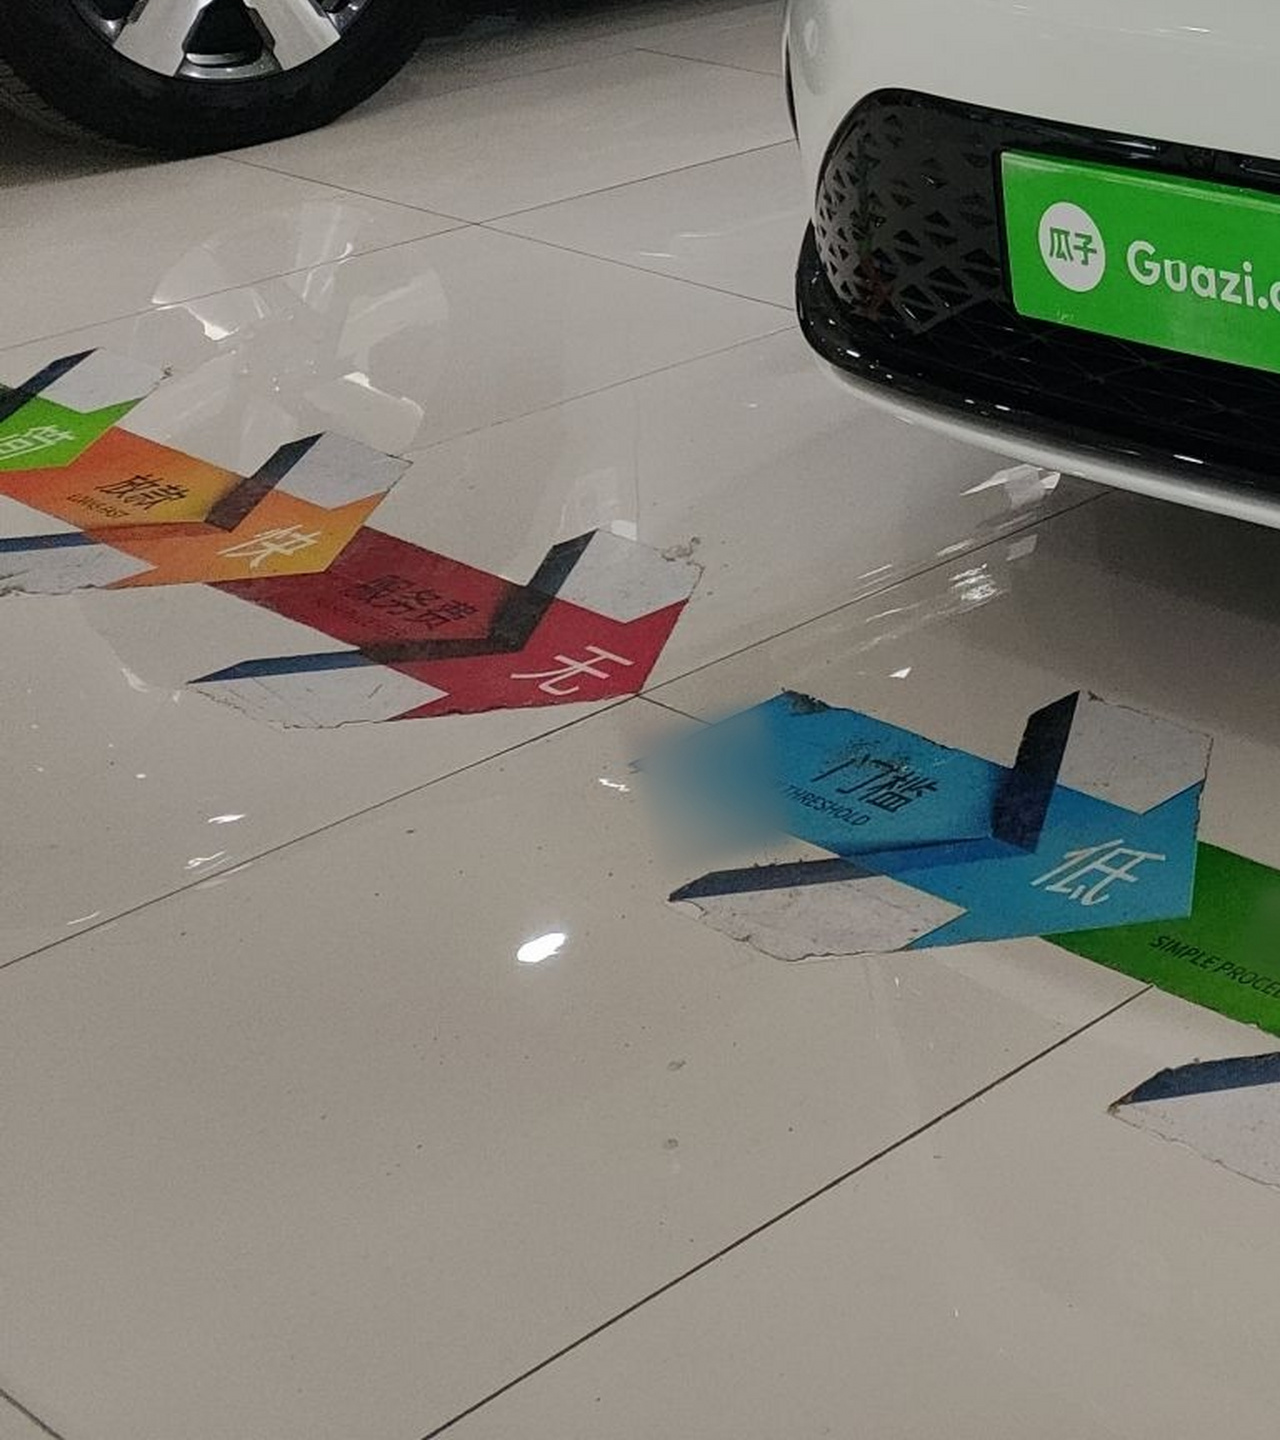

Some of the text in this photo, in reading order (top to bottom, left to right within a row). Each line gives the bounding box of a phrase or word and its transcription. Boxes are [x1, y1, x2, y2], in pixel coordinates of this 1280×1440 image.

[1048, 226, 1098, 266] 瓜子
[215, 524, 322, 569] 快
[510, 645, 636, 696] 无
[784, 783, 871, 827] THRESHOLD
[810, 752, 939, 814] 门槛
[1029, 838, 1166, 906] 低
[1150, 934, 1221, 970] SIMPLE
